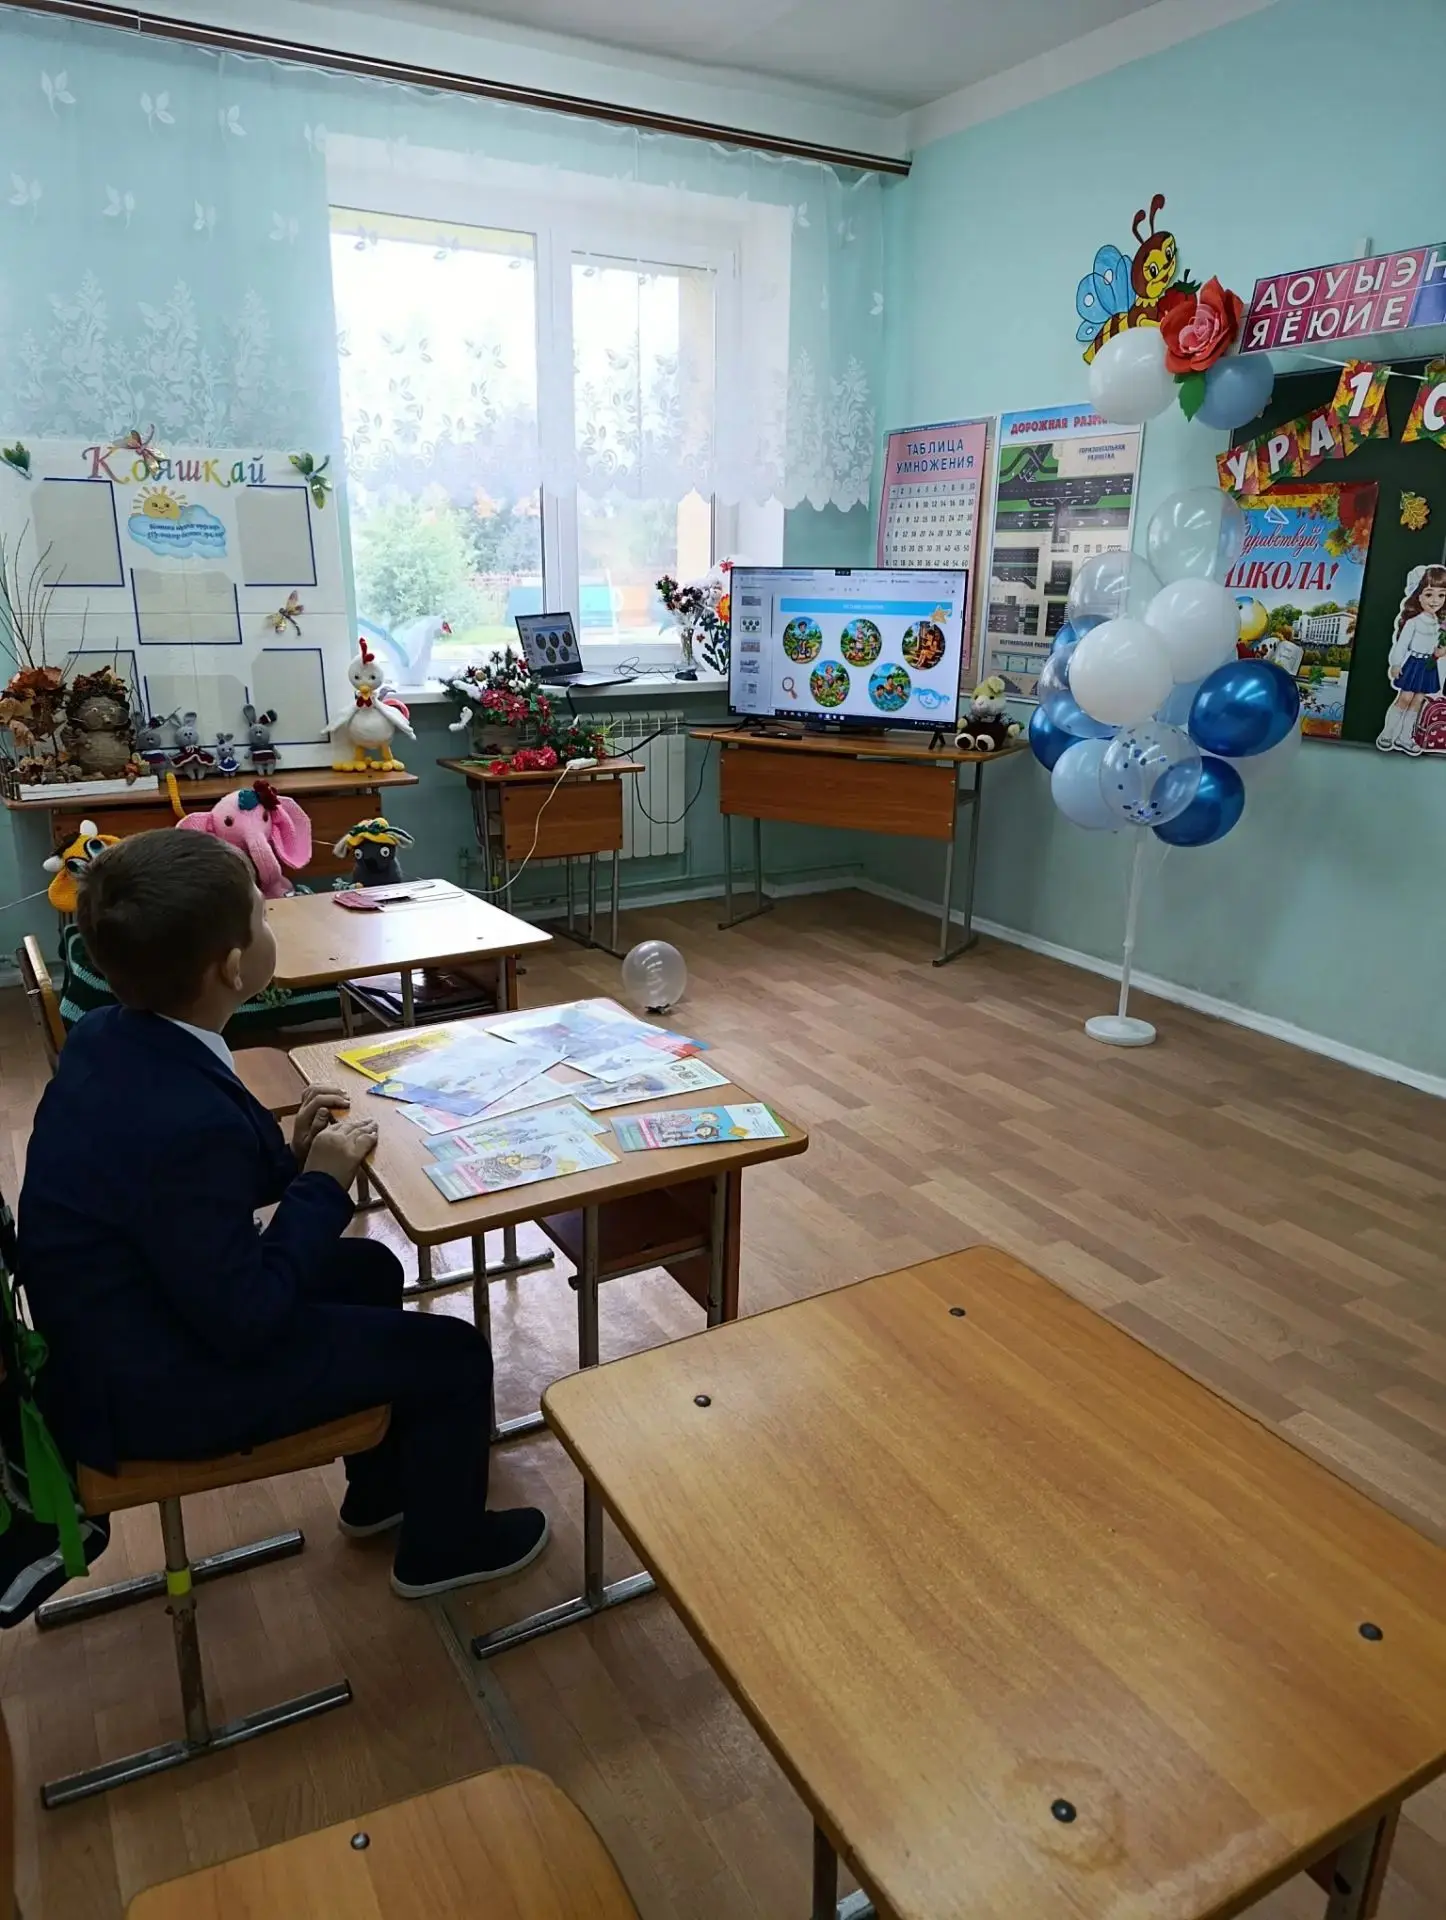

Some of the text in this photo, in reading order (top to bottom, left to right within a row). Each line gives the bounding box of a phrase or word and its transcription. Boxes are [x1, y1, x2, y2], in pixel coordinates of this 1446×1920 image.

[1010, 417, 1068, 435] ДОРОЖНАЯ
[1226, 415, 1336, 491] УРА
[1348, 371, 1374, 417] 1
[907, 438, 964, 456] ТАБЛИЦА
[896, 454, 974, 475] УМНОЖЕНИЯ
[1224, 560, 1340, 591] ШКОЛА!
